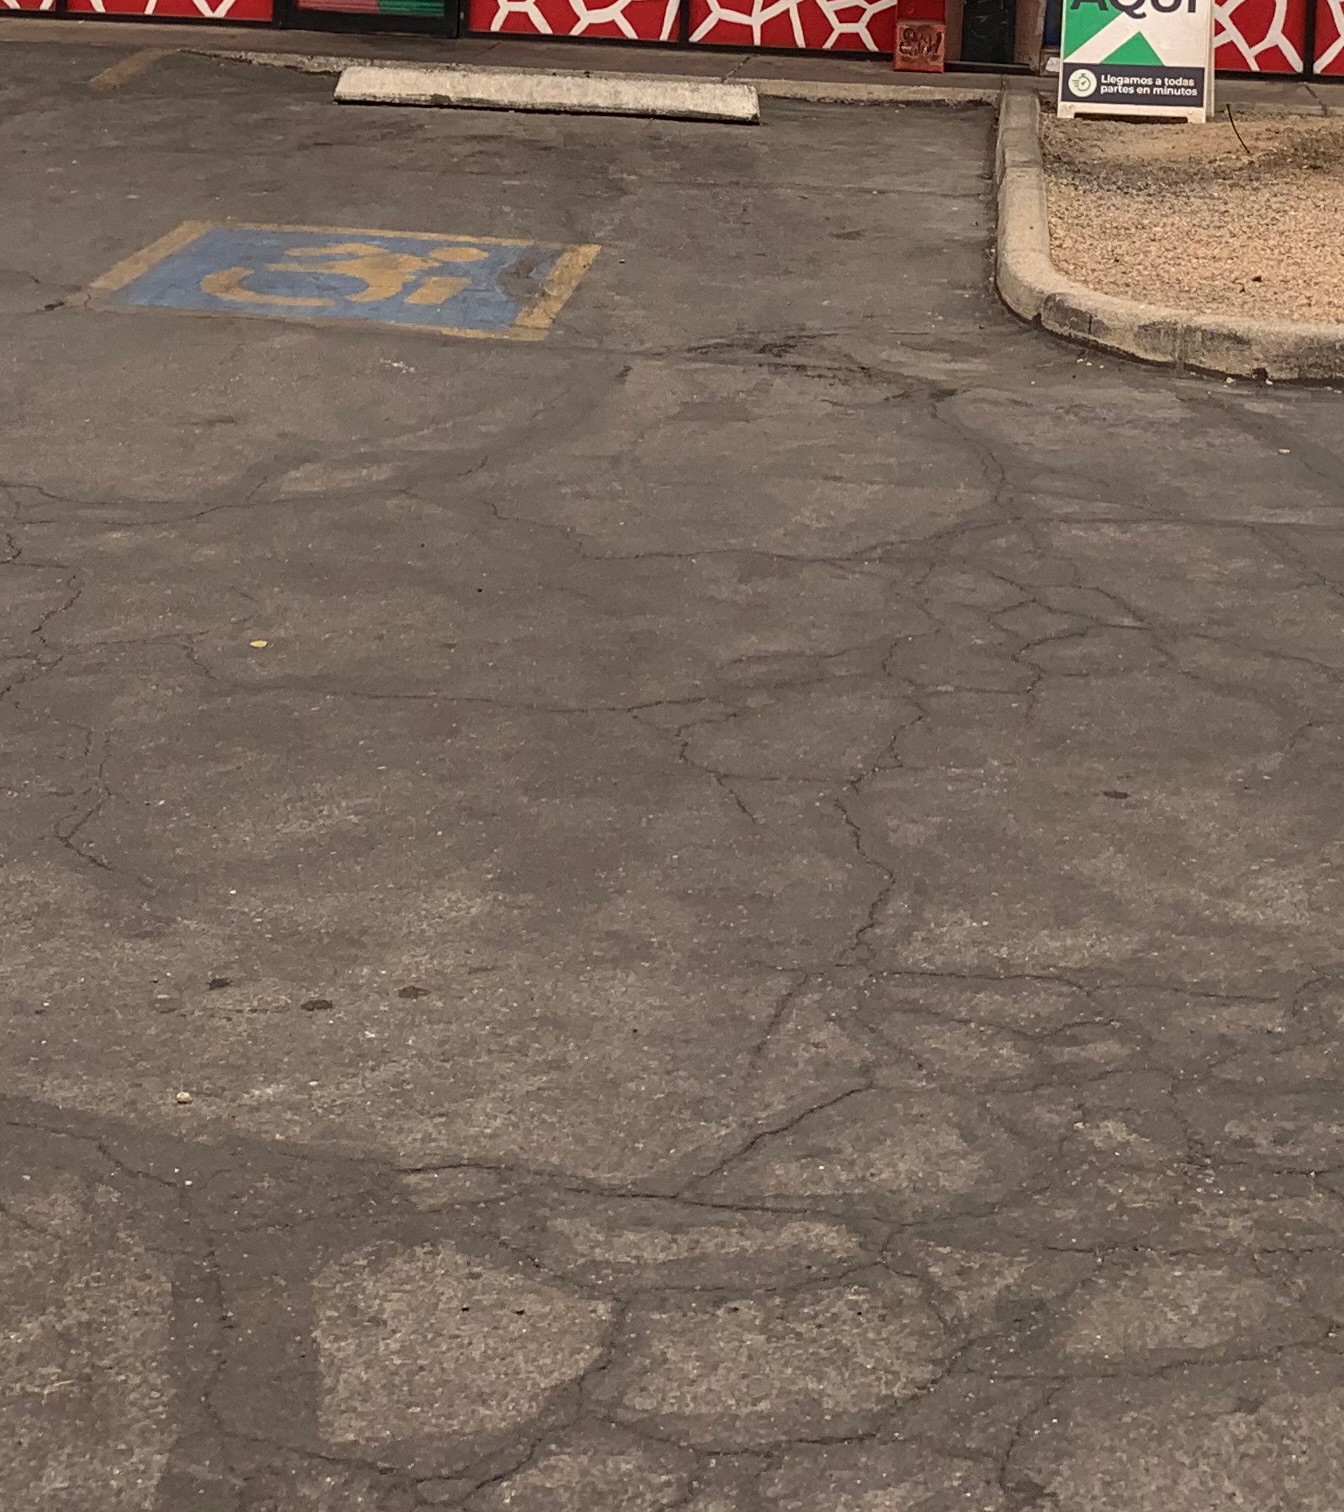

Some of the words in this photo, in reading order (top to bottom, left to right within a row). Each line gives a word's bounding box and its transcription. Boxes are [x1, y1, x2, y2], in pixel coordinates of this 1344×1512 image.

[1100, 74, 1153, 86] Llegamos
[1164, 76, 1195, 87] todas
[1100, 84, 1134, 94] partes
[1153, 86, 1198, 96] minutos
